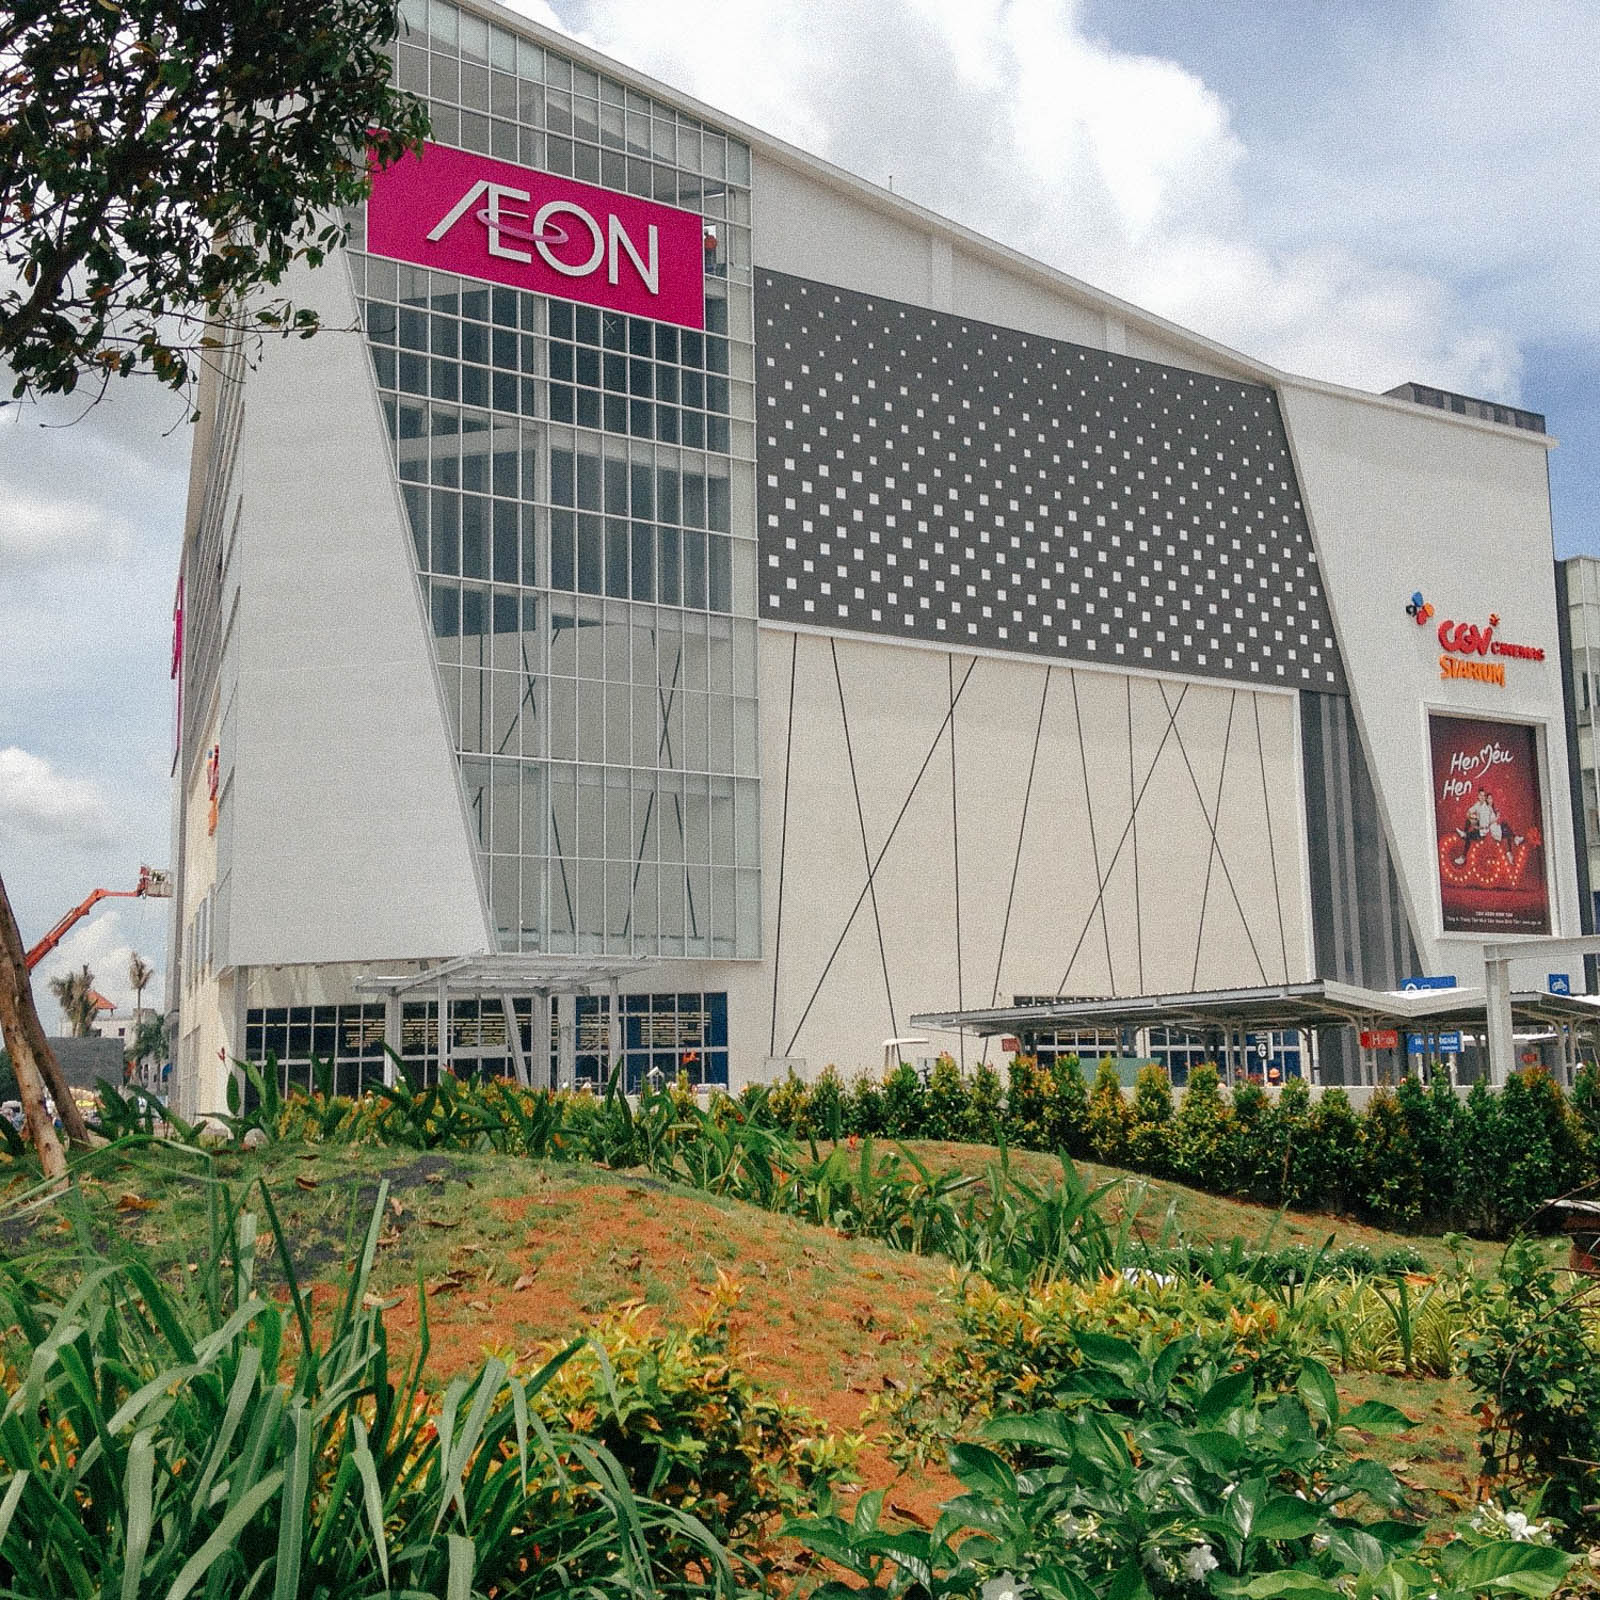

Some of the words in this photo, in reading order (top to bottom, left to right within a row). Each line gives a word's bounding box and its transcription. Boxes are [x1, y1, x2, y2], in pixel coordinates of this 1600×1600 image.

[1438, 619, 1493, 656] CGV
[1439, 655, 1506, 688] STARIUM
[1450, 752, 1479, 776] Hẹn
[1442, 778, 1472, 801] Hẹn
